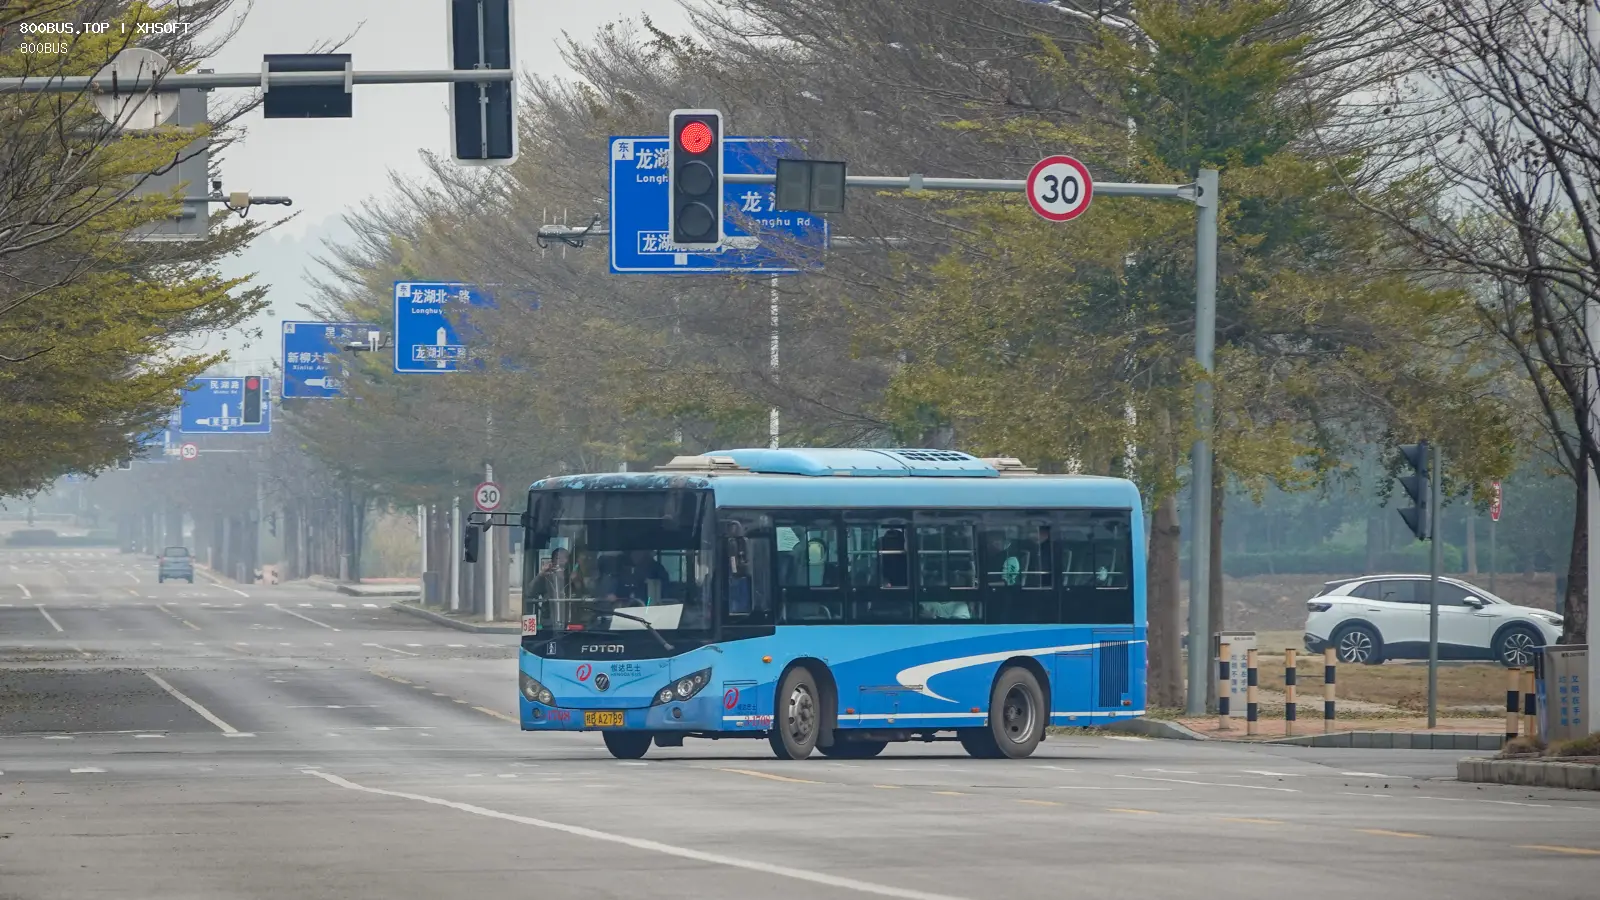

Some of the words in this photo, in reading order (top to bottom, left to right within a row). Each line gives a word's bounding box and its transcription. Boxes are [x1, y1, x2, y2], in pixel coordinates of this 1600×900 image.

[618, 142, 629, 152] 东
[1041, 174, 1079, 205] 30
[797, 217, 811, 226] Rd
[411, 289, 471, 304] 龙湖北一路
[184, 447, 195, 456] 30
[480, 490, 497, 503] 30
[581, 644, 625, 653] FOTON
